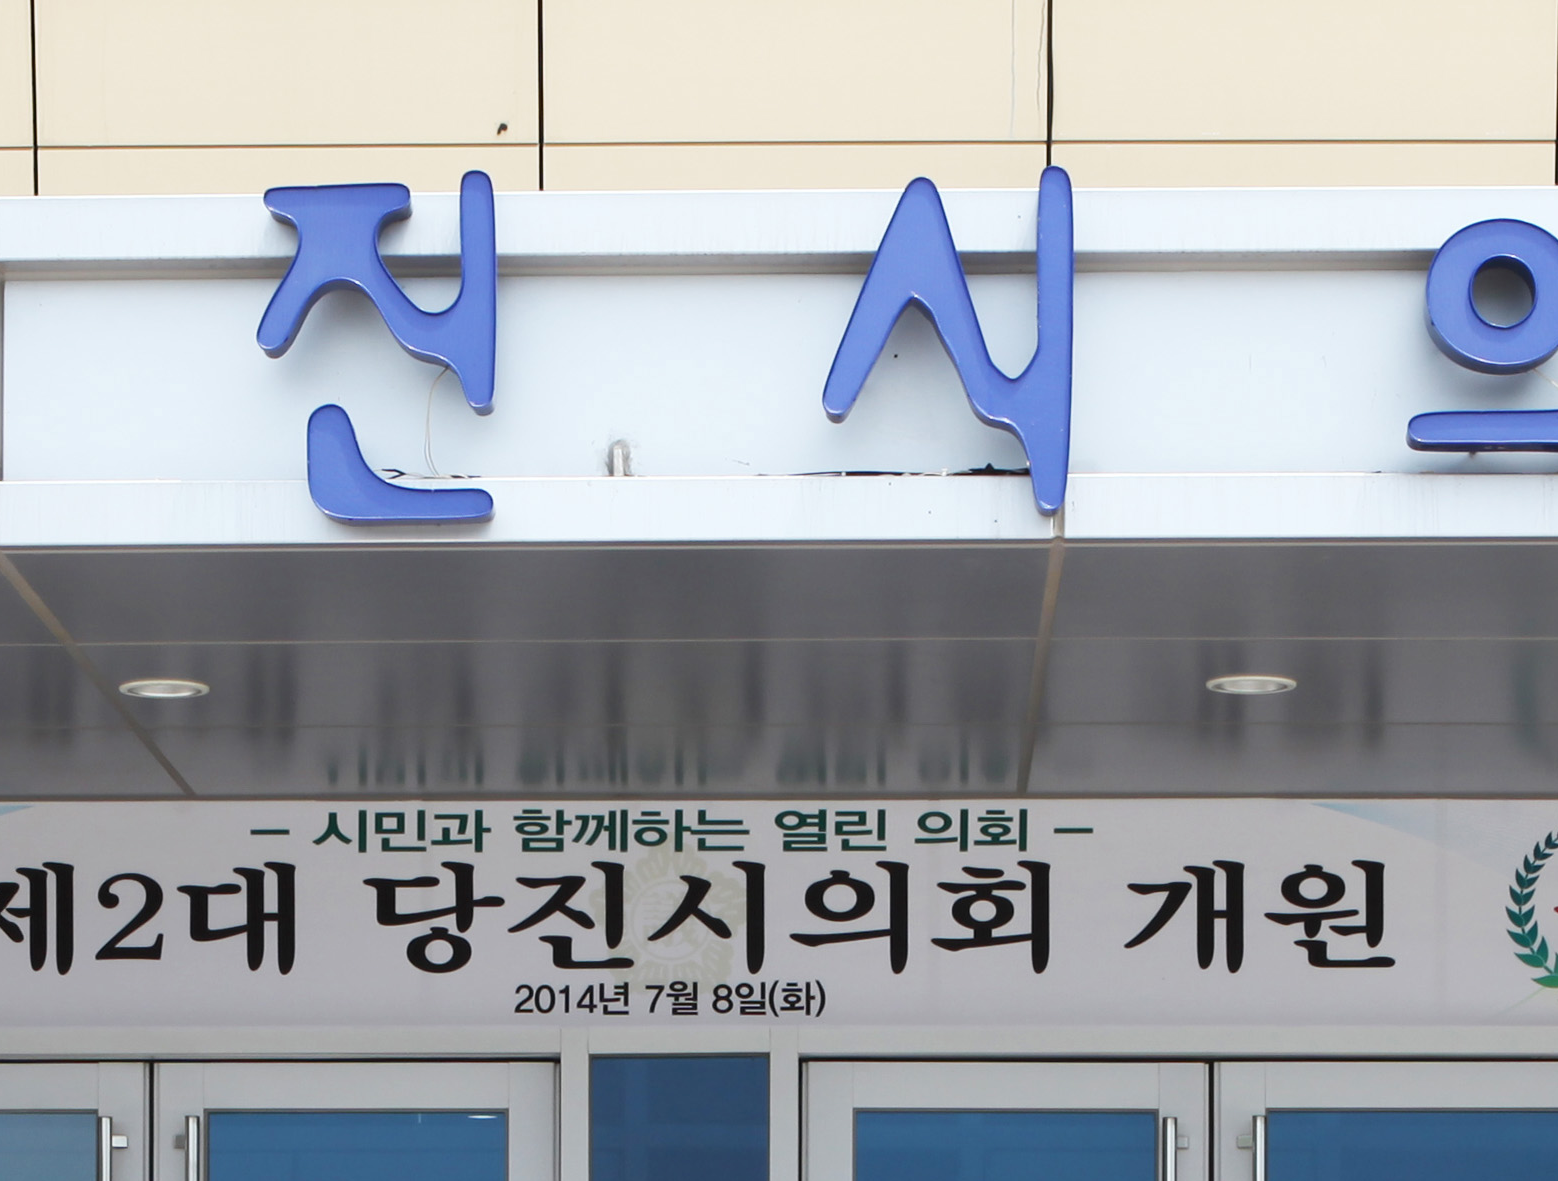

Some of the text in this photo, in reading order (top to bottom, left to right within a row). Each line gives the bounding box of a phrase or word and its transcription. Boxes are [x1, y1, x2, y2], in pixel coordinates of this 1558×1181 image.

[311, 808, 1030, 855] 시민과 함께하는 열린 의회
[363, 860, 1053, 976] 당진시의회
[1125, 859, 1397, 975] 개원
[513, 980, 827, 1018] 2014년 7월 8일(화)
